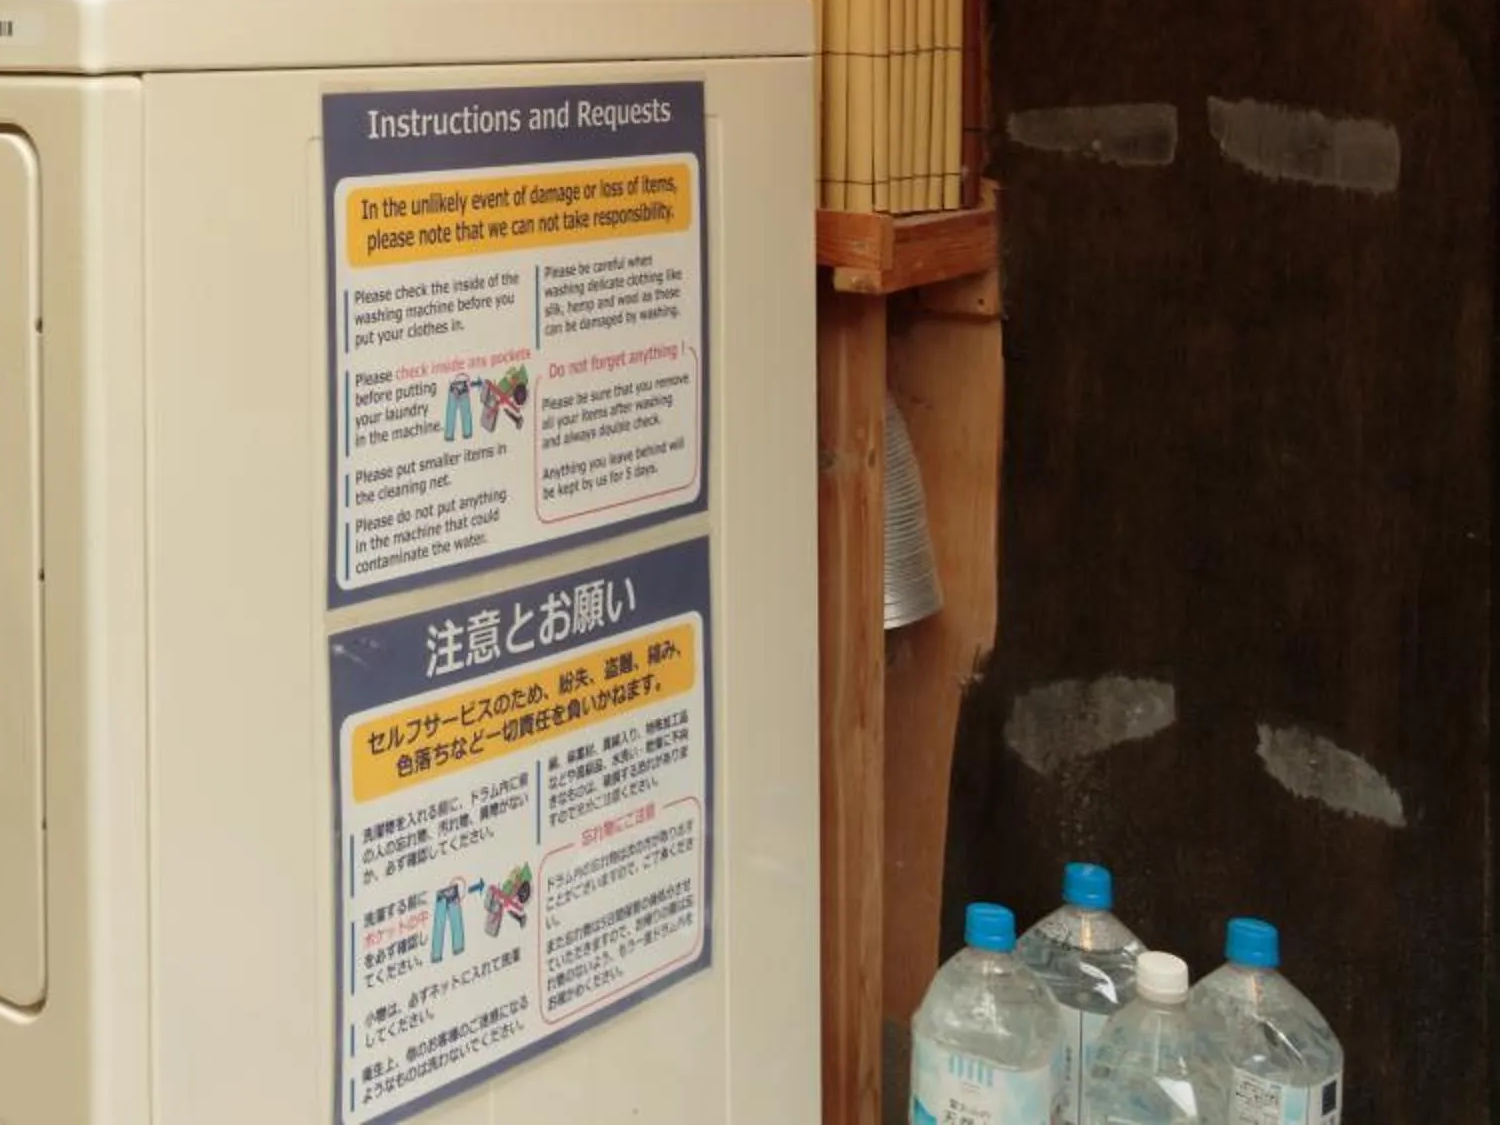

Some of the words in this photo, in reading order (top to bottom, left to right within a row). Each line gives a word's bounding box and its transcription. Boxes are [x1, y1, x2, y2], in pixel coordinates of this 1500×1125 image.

[368, 105, 521, 139] Instructions
[529, 101, 569, 130] and
[578, 99, 671, 132] Requests
[361, 199, 378, 220] In
[383, 197, 407, 218] the
[412, 191, 468, 216] unlikely
[472, 188, 508, 210] event
[514, 184, 529, 205] of
[530, 183, 580, 207] damage
[583, 186, 596, 199] or
[600, 179, 623, 196] loss
[627, 178, 639, 195] of
[641, 175, 677, 196] items,
[367, 228, 414, 255] please
[419, 225, 450, 246] note
[455, 221, 484, 242] that
[488, 221, 507, 238] we
[511, 218, 534, 235] can
[539, 214, 560, 233] not
[564, 209, 589, 230] take
[593, 201, 675, 228] responsibility.
[544, 266, 576, 278] Please
[578, 263, 590, 274] be
[593, 257, 625, 273] careful
[628, 255, 652, 267] when
[545, 282, 585, 297] washing
[588, 277, 624, 291] delicate
[627, 271, 663, 286] clothing
[666, 268, 682, 280] like
[354, 289, 392, 304] Please
[395, 283, 427, 300] check
[431, 281, 449, 295] the
[453, 277, 485, 293] inside
[488, 273, 499, 287] of
[502, 273, 519, 286] the
[567, 298, 595, 313] hemp
[598, 295, 614, 308] and
[618, 293, 639, 305] wool
[642, 291, 652, 302] as
[355, 307, 403, 325] washing
[406, 301, 454, 317] machine
[458, 296, 492, 312] before
[495, 293, 515, 308] you
[545, 324, 563, 336] can
[565, 319, 577, 332] be
[580, 312, 623, 329] damaged
[626, 311, 637, 324] by
[355, 332, 374, 350] put
[378, 328, 403, 346] your
[408, 321, 448, 338] clothes
[451, 319, 465, 332] in.
[355, 371, 392, 387] Please
[395, 363, 430, 380] check
[431, 357, 465, 376] inside
[490, 347, 531, 367] pockets
[549, 363, 565, 378] Do
[569, 358, 587, 374] not
[591, 353, 626, 371] forget
[629, 344, 678, 363] anything
[355, 390, 393, 406] before
[396, 382, 437, 400] putting
[542, 396, 574, 410] Please
[576, 392, 588, 404] be
[591, 389, 612, 401] sure
[614, 382, 633, 396] that
[636, 380, 652, 395] you
[655, 374, 689, 388] remove
[355, 412, 382, 429] your
[385, 403, 429, 421] laundry
[557, 414, 579, 428] your
[582, 408, 608, 421] items
[610, 402, 632, 414] after
[636, 394, 673, 410] washing
[355, 433, 366, 447] in
[369, 428, 389, 444] the
[392, 420, 443, 440] machine.
[542, 434, 561, 449] and
[564, 428, 596, 444] always
[599, 421, 631, 436] double
[356, 468, 393, 485] Please
[396, 460, 416, 479] put
[419, 452, 461, 471] smaller
[464, 447, 494, 462] items
[497, 442, 507, 455] in
[543, 461, 586, 480] Anything
[590, 456, 606, 471] you
[609, 451, 633, 464] leave
[636, 442, 667, 459] behind
[669, 436, 685, 450] will
[356, 491, 374, 505] the
[378, 480, 426, 500] cleaning
[430, 475, 452, 488] net.
[543, 487, 555, 500] be
[558, 480, 579, 497] kept
[582, 477, 593, 491] by
[596, 475, 608, 486] us
[610, 470, 623, 483] for
[626, 467, 632, 480] 5
[634, 463, 658, 477] days.
[356, 515, 394, 533] Please
[397, 509, 412, 524] do
[415, 504, 433, 519] not
[437, 498, 455, 518] put
[459, 489, 507, 511] anything
[356, 539, 367, 553] in
[370, 534, 390, 550] the
[393, 524, 442, 545] machine
[444, 515, 468, 532] that
[471, 507, 499, 526] could
[355, 545, 429, 574] contaminate
[431, 539, 451, 556] the
[425, 577, 636, 678] 注意とお願い
[396, 673, 662, 778] 色落ちなど一切責任を負いかねます。
